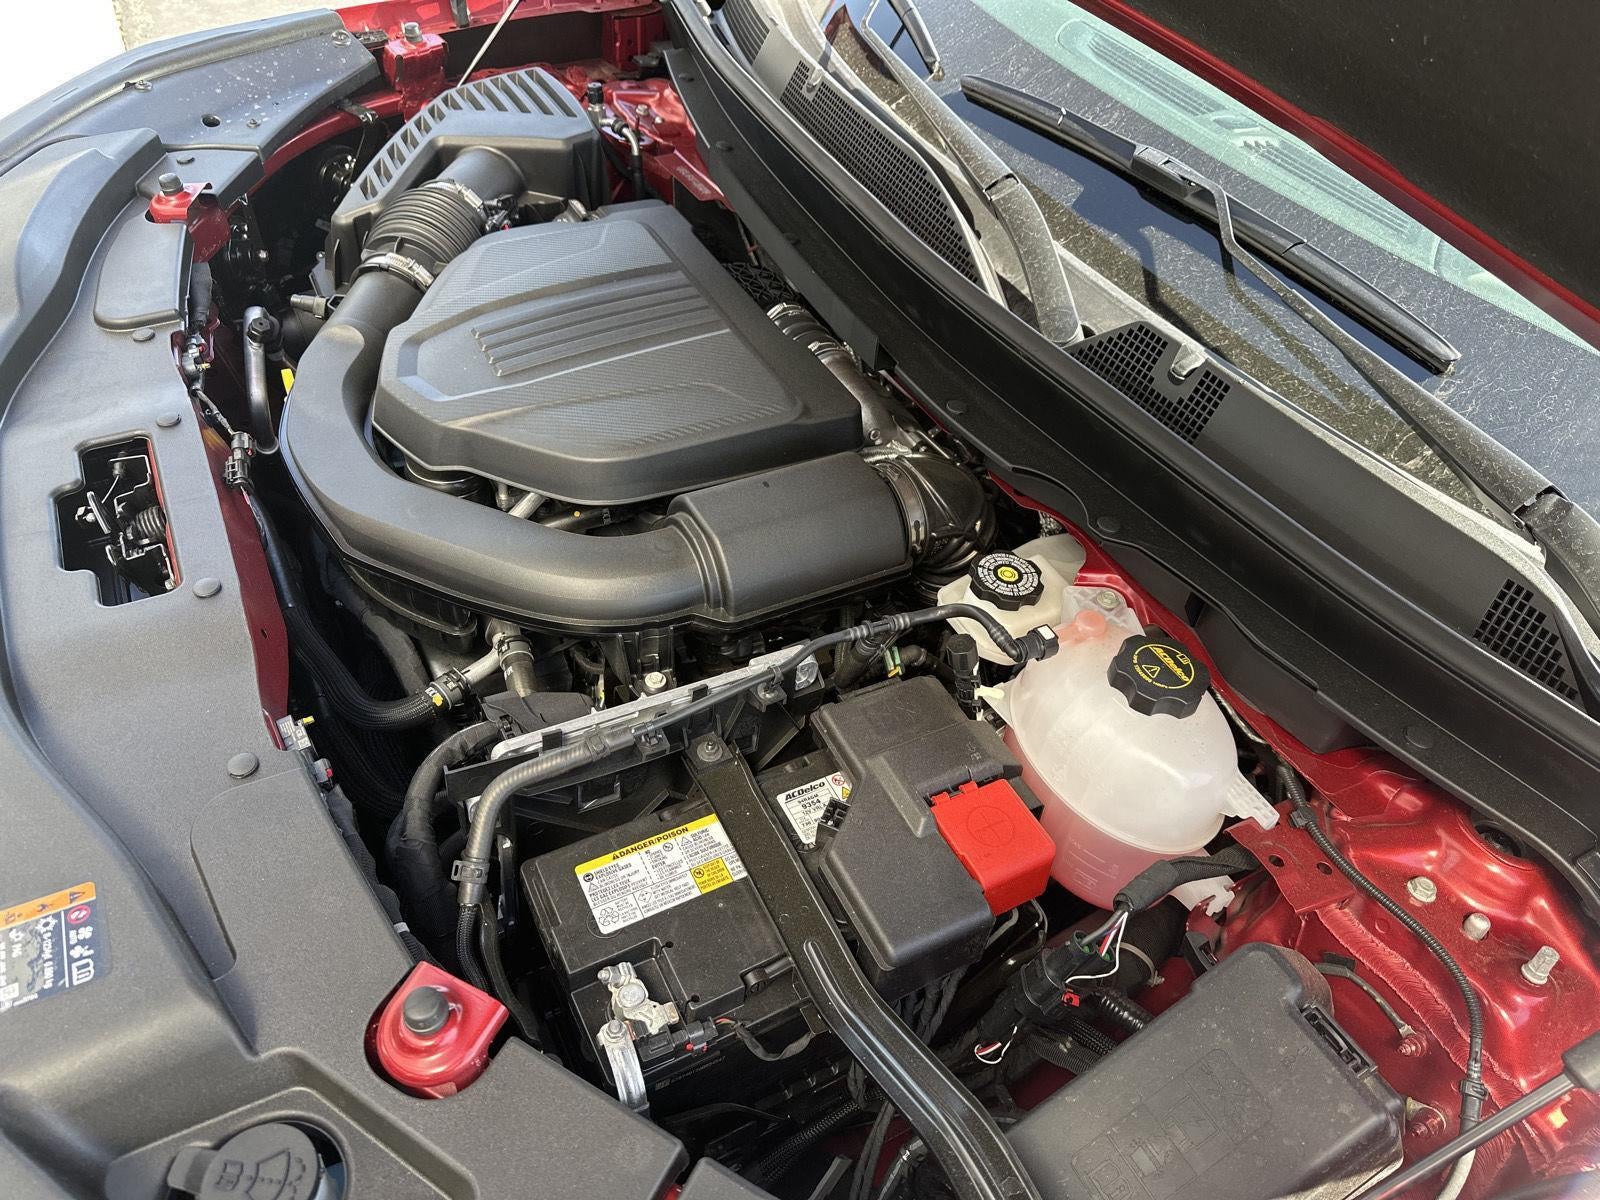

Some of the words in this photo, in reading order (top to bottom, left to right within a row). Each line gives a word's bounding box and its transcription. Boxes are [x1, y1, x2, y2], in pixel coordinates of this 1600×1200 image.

[1152, 646, 1190, 682] ACDelco
[783, 780, 825, 800] ACDelco
[801, 798, 821, 809] 9354
[618, 826, 688, 857] DANGER/POISON
